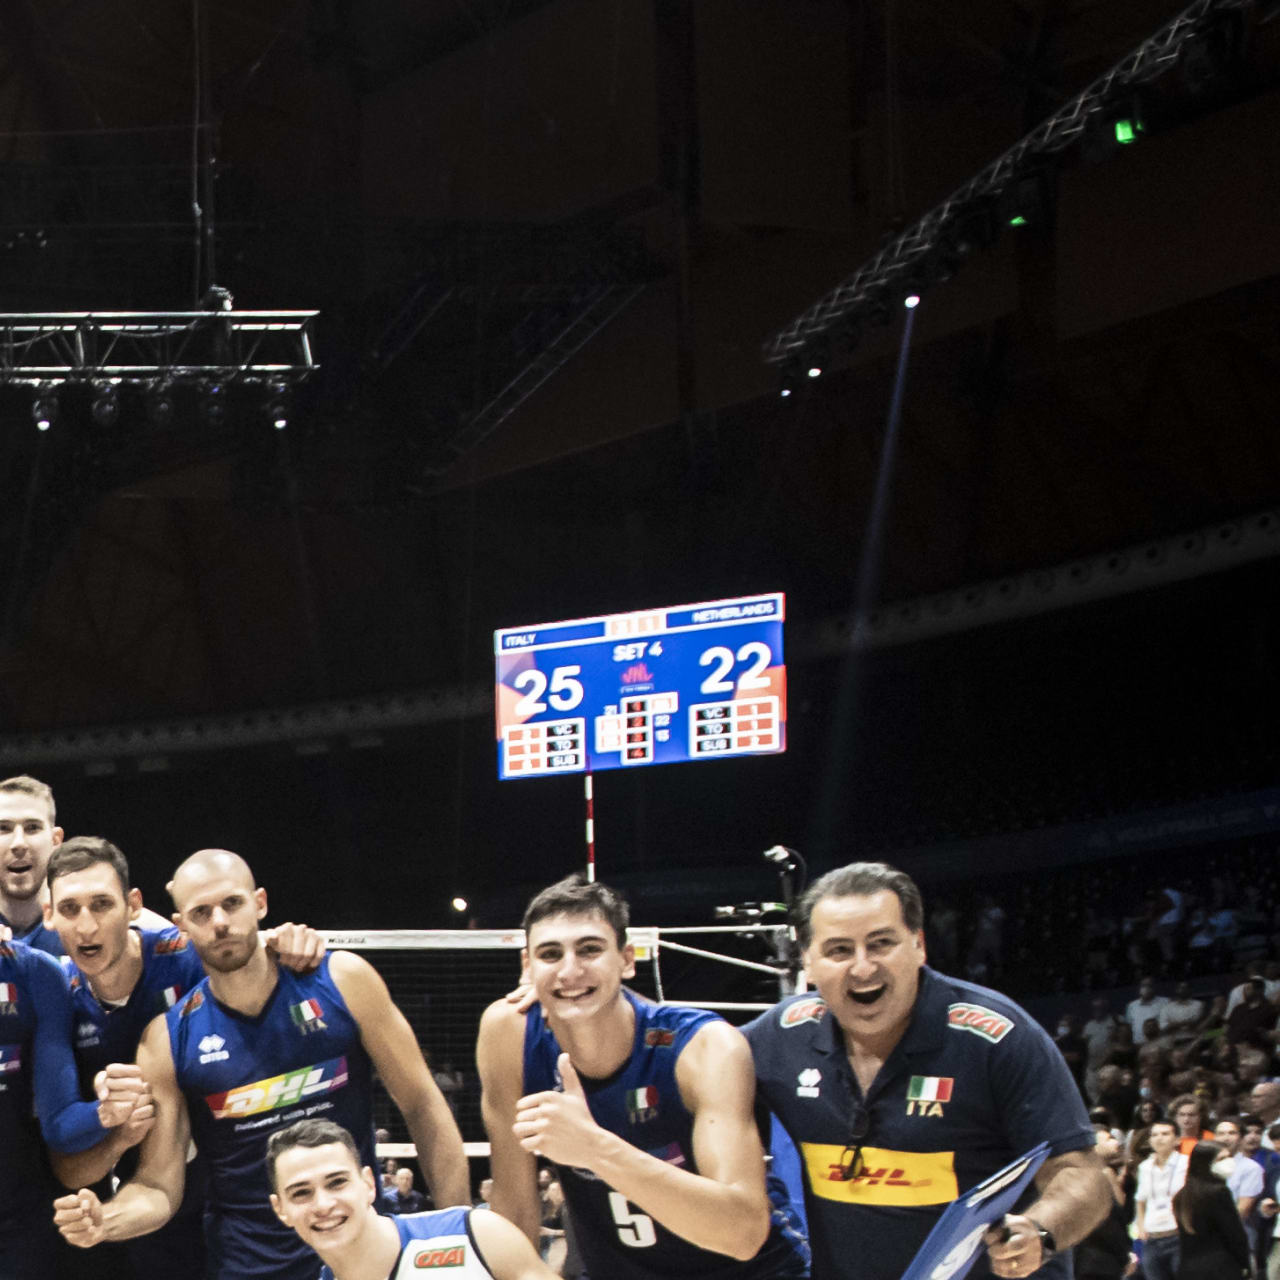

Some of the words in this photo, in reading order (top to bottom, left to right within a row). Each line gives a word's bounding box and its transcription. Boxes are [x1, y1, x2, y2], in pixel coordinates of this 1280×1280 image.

[692, 602, 774, 623] NETHERLANDS
[505, 633, 536, 647] ITALY
[613, 642, 648, 662] SET
[648, 640, 663, 657] 4
[699, 641, 772, 694] 22
[514, 664, 584, 716] 25
[704, 707, 724, 719] VC
[553, 724, 575, 736] VC
[706, 722, 724, 734] TO
[701, 738, 728, 752] SUB
[552, 755, 578, 767] SUB
[950, 1007, 1007, 1036] CRAI
[225, 1067, 334, 1114] DHL
[906, 1101, 943, 1118] ITA
[828, 1164, 912, 1187] DHL
[608, 1191, 657, 1248] 5
[415, 1249, 465, 1267] CRAI
